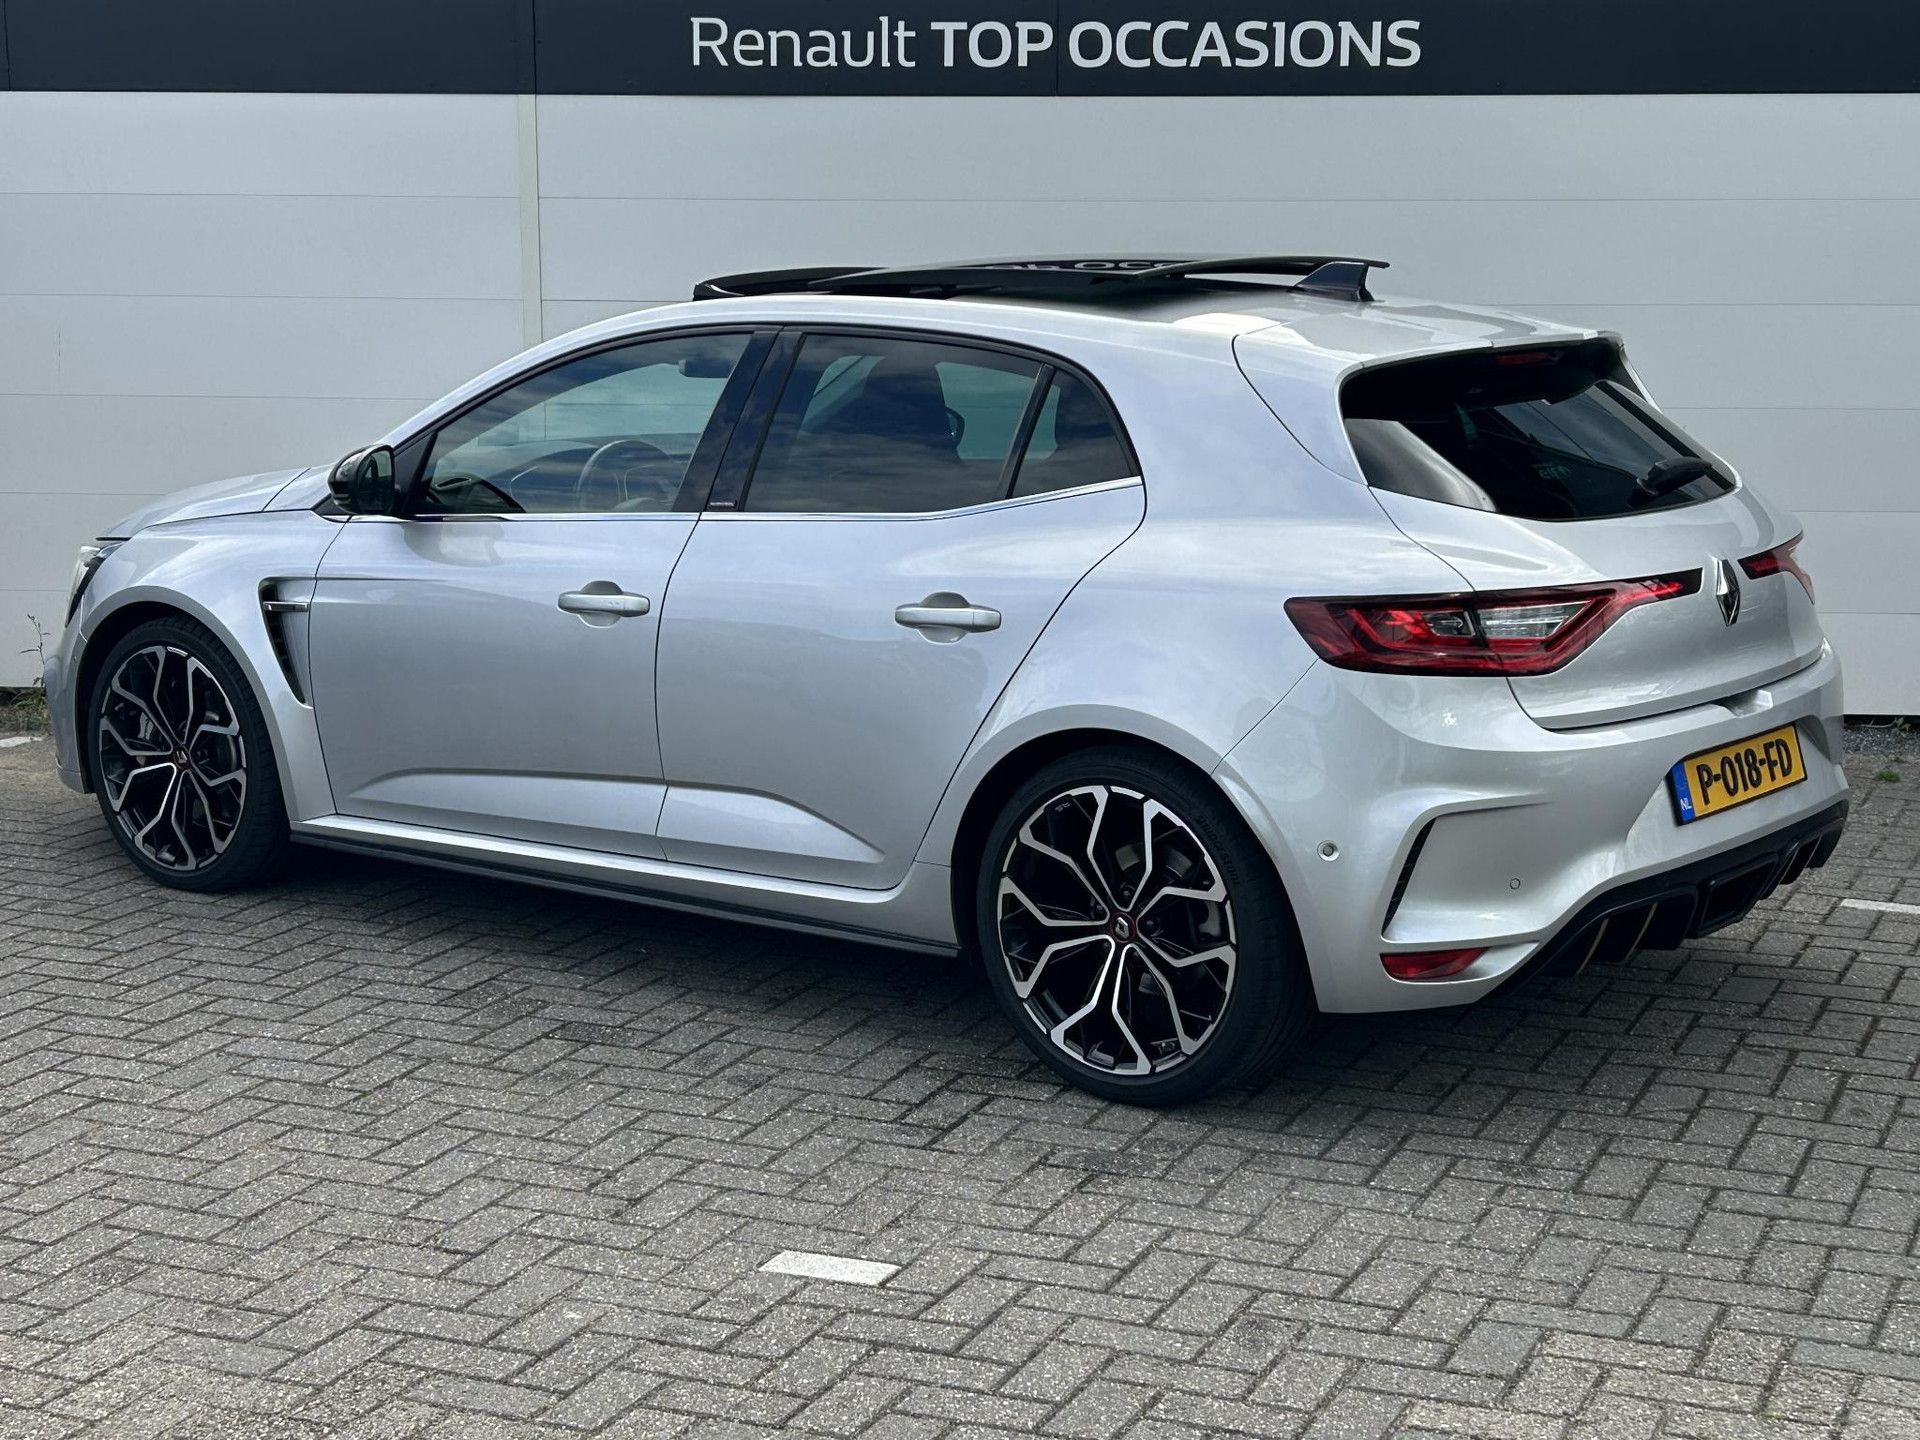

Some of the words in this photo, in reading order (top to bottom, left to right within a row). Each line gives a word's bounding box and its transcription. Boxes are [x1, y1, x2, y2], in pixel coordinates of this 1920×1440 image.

[691, 17, 916, 68] Renault
[931, 21, 1054, 68] TOP
[1069, 20, 1421, 68] OCCASIONS
[1696, 738, 1793, 806] P-018-FD
[1680, 797, 1692, 811] NL
